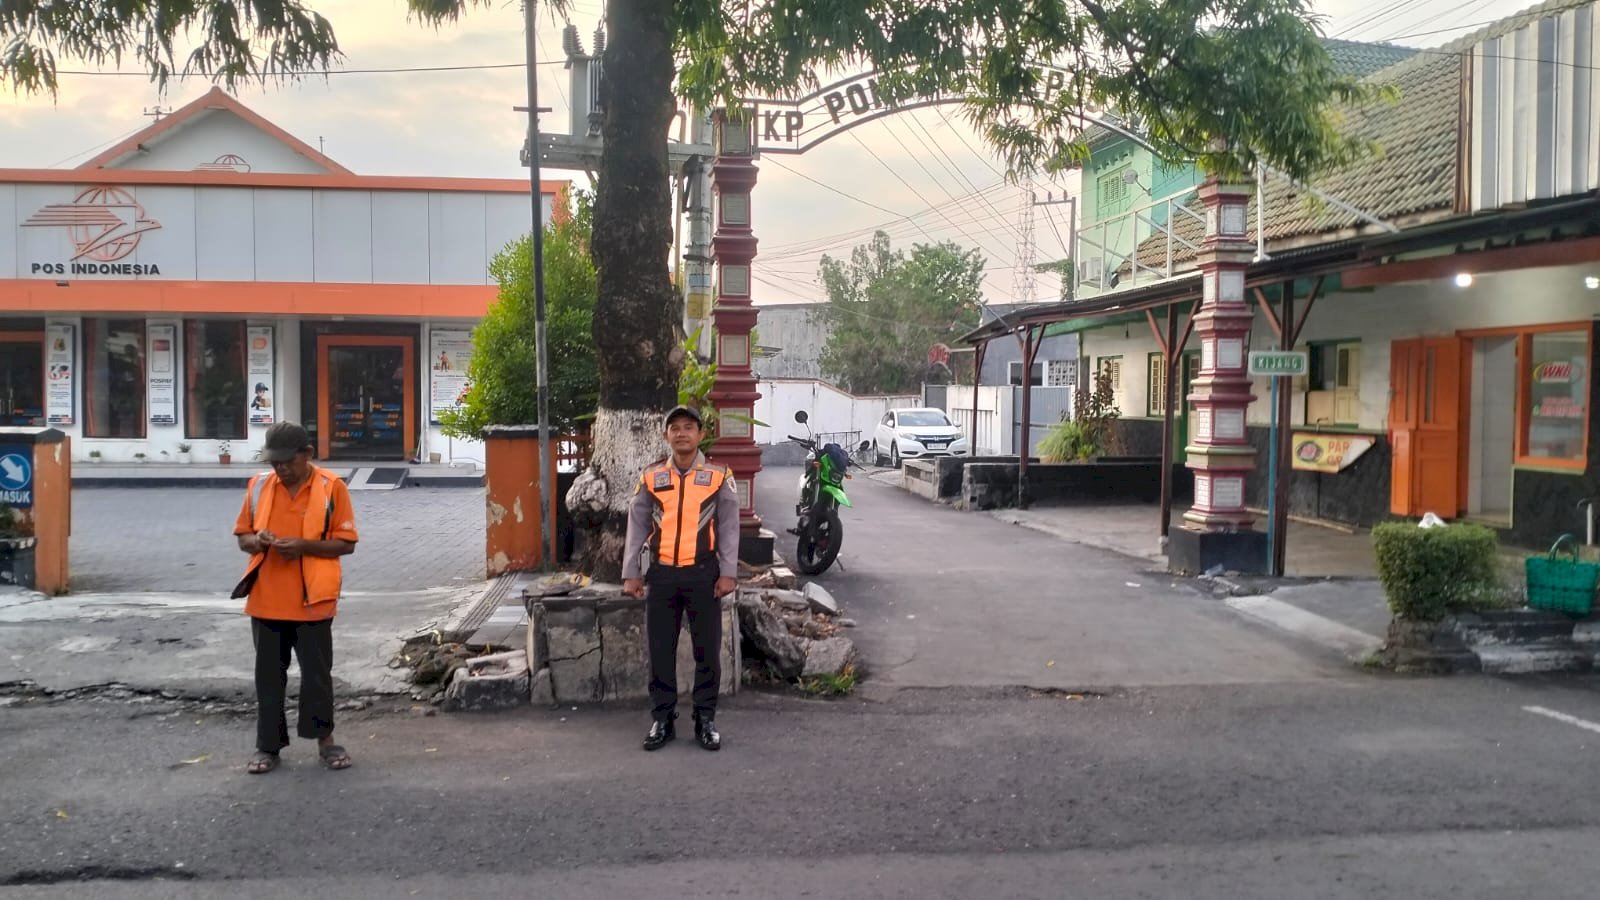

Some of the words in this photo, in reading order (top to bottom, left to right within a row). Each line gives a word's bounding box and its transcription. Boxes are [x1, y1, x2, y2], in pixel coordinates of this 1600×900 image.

[764, 110, 803, 142] KP
[31, 263, 65, 274] POS
[71, 264, 161, 275] INDONESIA
[1257, 357, 1298, 369] KIJANG
